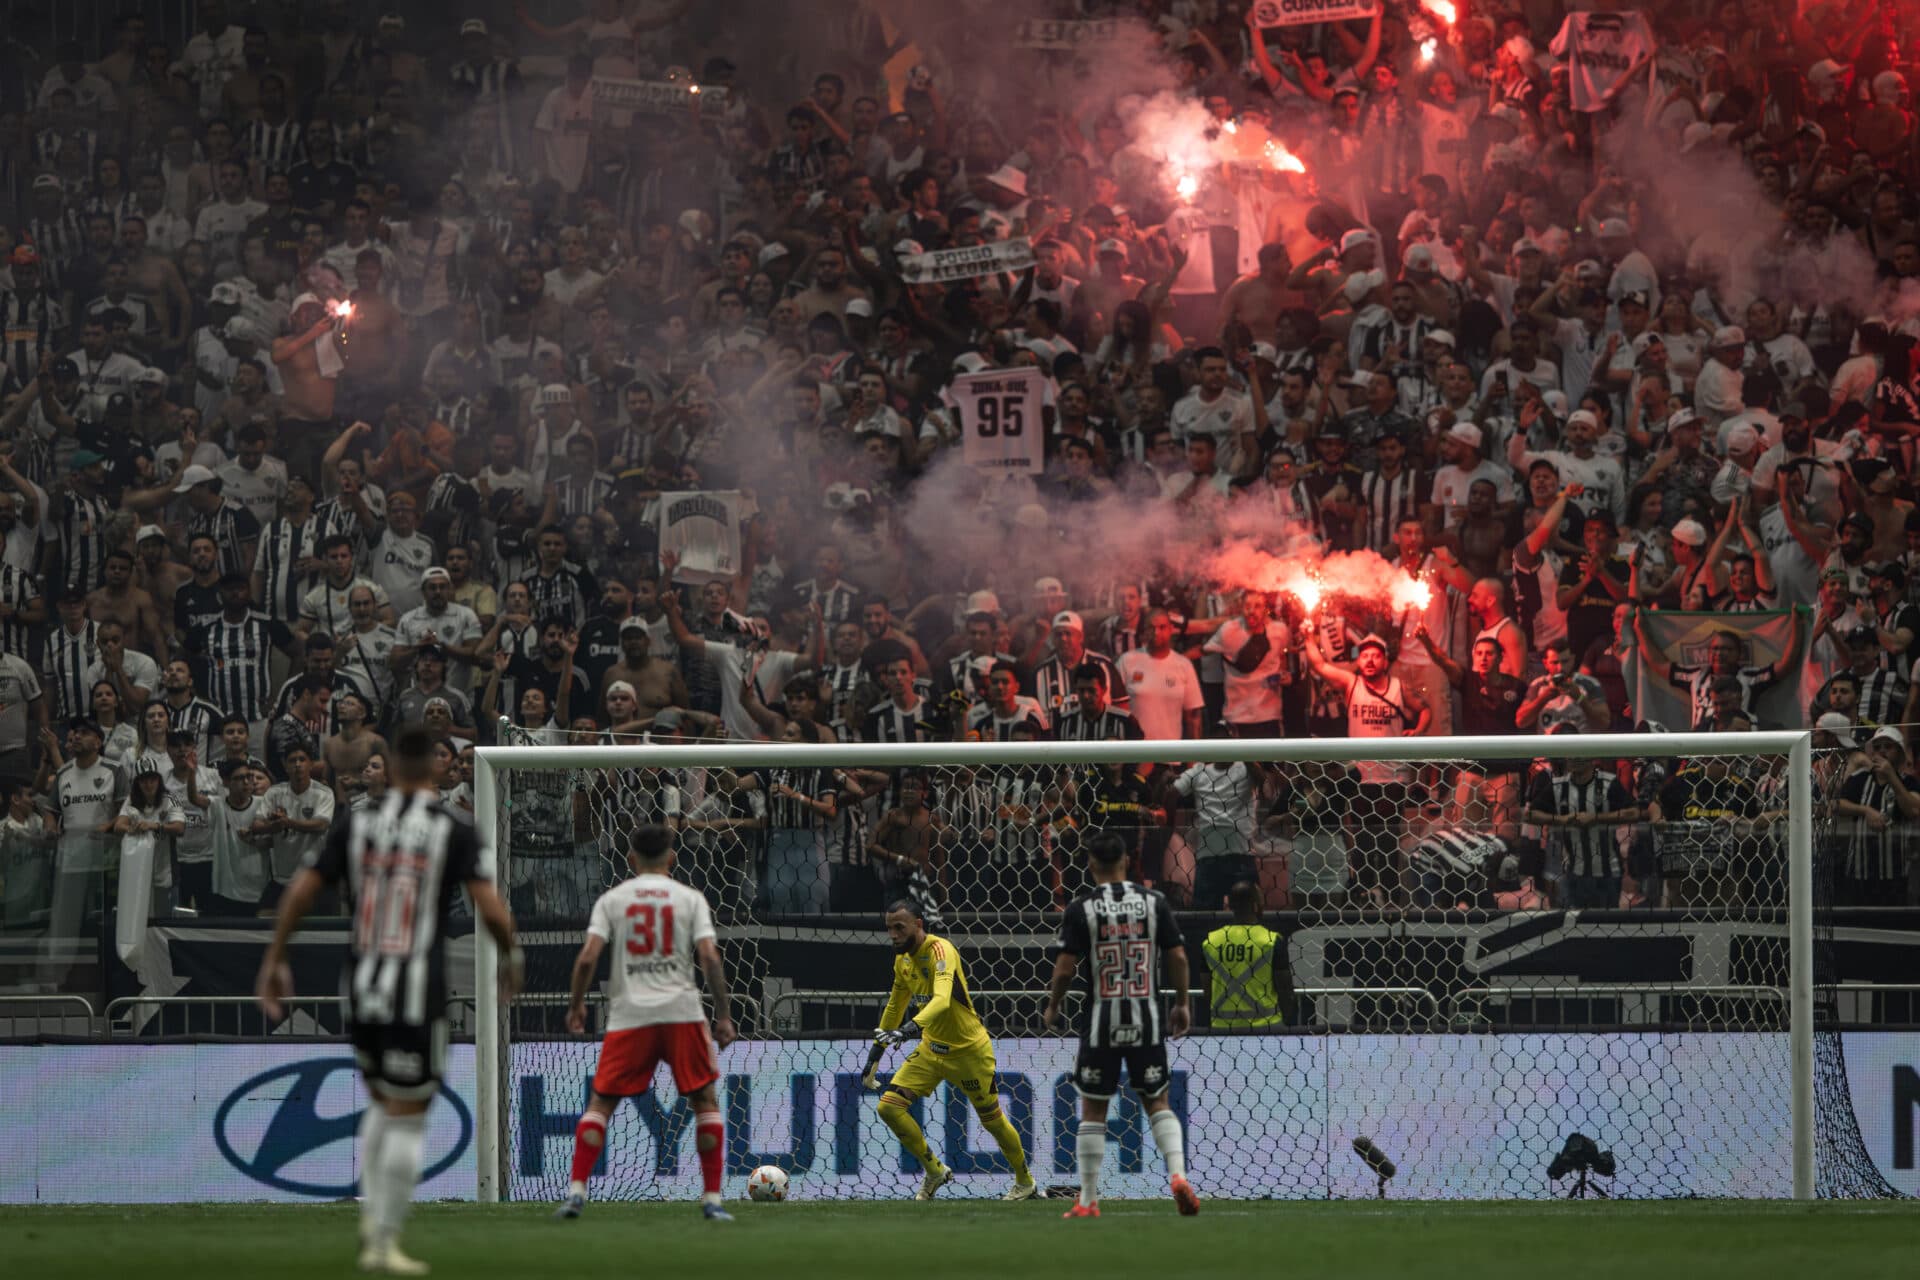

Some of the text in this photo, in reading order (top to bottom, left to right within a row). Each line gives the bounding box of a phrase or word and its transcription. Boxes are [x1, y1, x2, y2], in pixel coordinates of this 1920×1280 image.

[932, 258, 1001, 280] ALEGRE
[933, 246, 993, 266] POUSO
[977, 396, 1024, 438] 95
[71, 793, 107, 804] BETANO
[626, 903, 674, 956] 31
[1219, 943, 1255, 962] 1091
[1096, 941, 1152, 998] 23
[520, 1070, 1188, 1177] HYUNDAI
